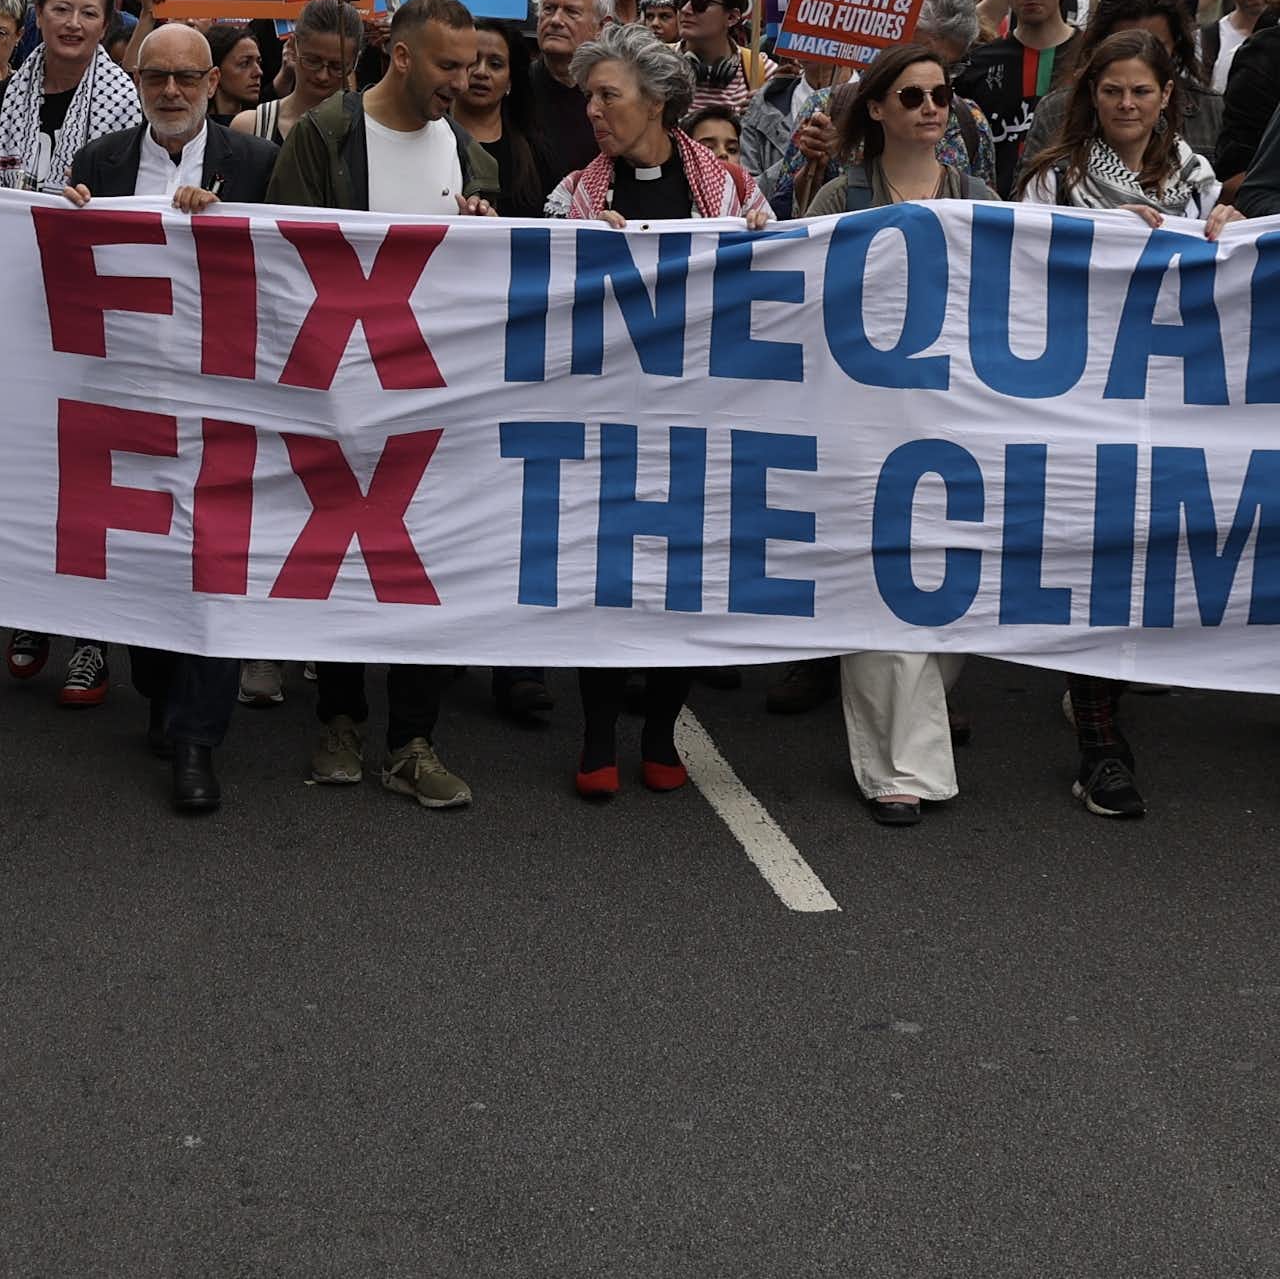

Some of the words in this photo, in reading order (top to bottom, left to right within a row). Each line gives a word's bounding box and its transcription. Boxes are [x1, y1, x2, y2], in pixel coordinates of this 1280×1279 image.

[833, 5, 906, 41] FUTURES
[30, 206, 451, 391] FIX
[55, 397, 446, 606] FIX
[498, 421, 818, 618] THE
[871, 438, 1280, 628] CLIM
